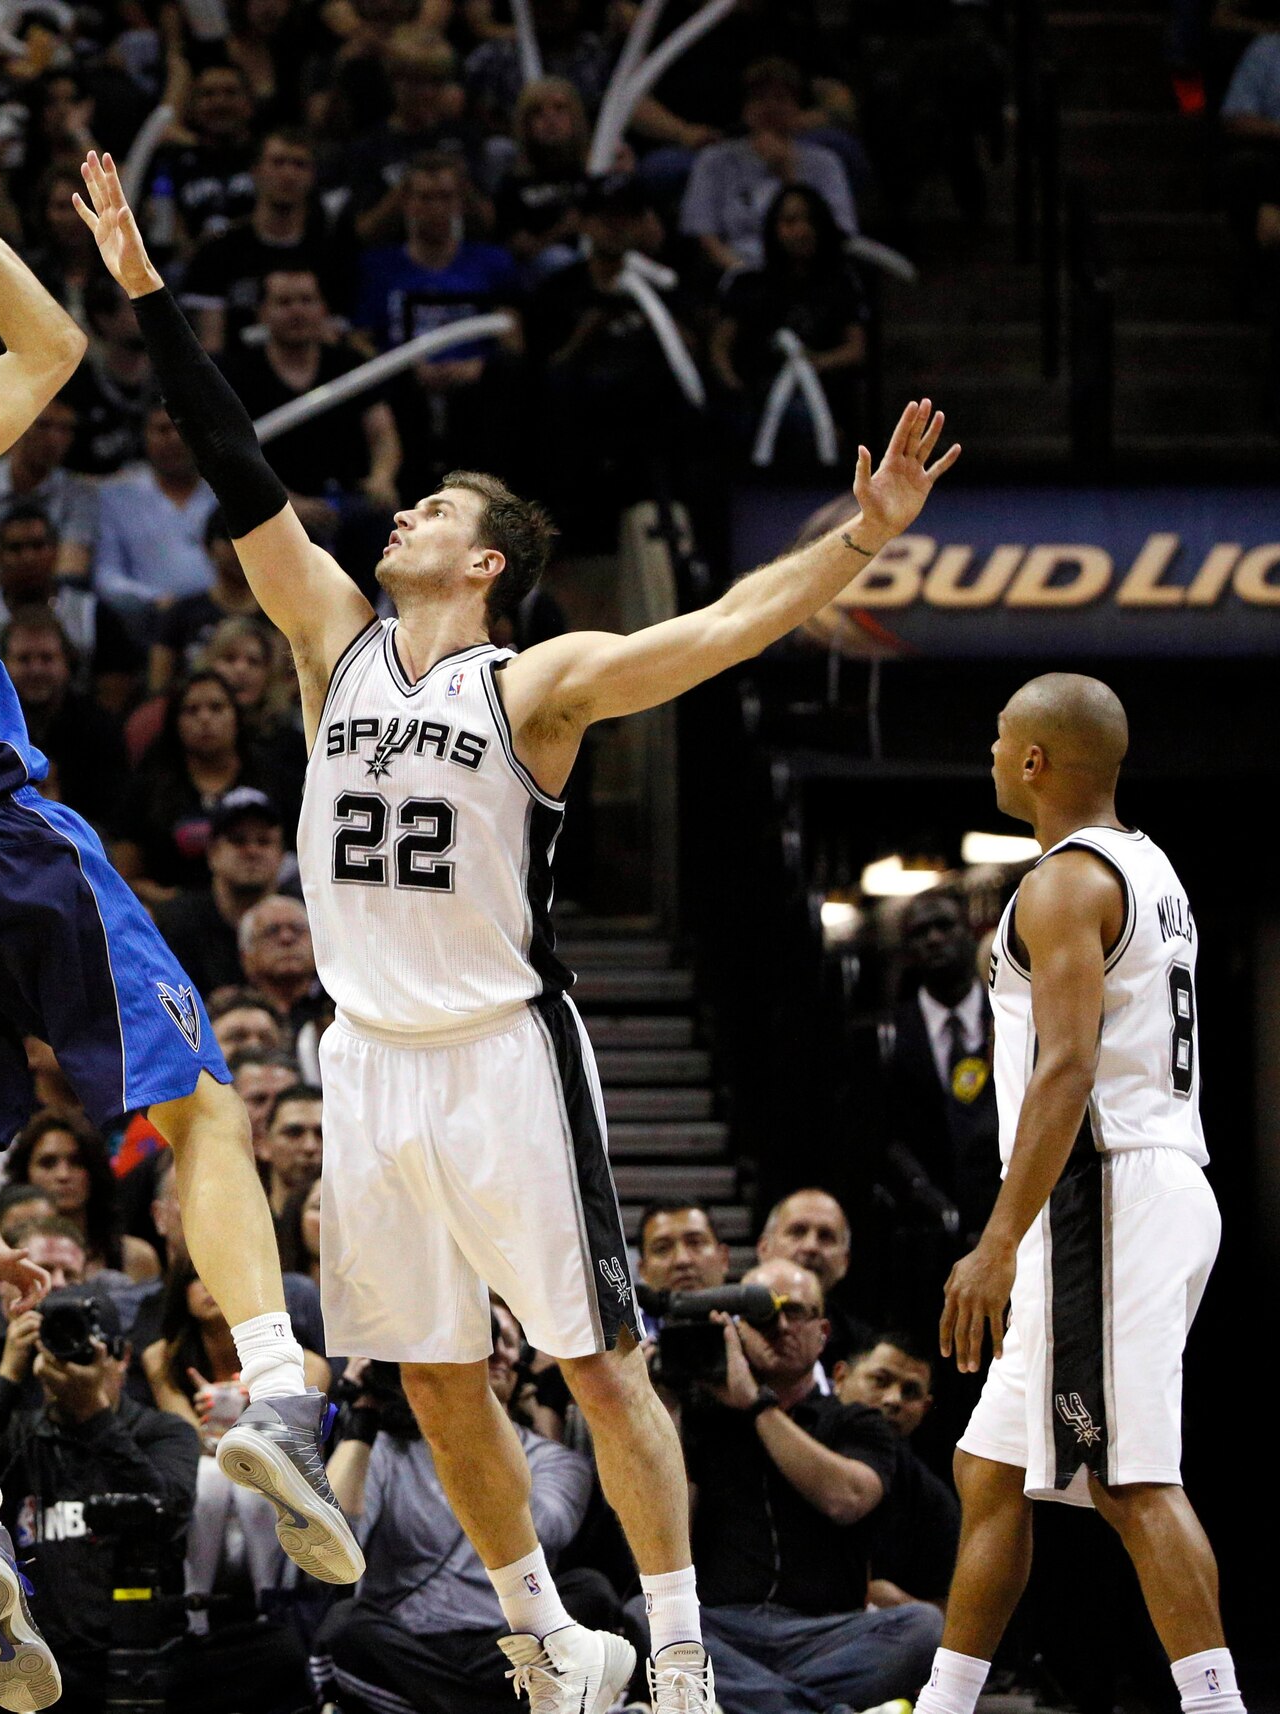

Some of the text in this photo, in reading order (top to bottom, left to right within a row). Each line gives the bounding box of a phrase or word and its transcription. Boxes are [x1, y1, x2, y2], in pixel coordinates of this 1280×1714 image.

[836, 533, 1114, 608] BUD
[326, 716, 491, 774] SPURS
[331, 789, 458, 894] 22
[1157, 895, 1193, 945] MILLS
[1165, 958, 1194, 1102] 8
[45, 1500, 87, 1541] NB
